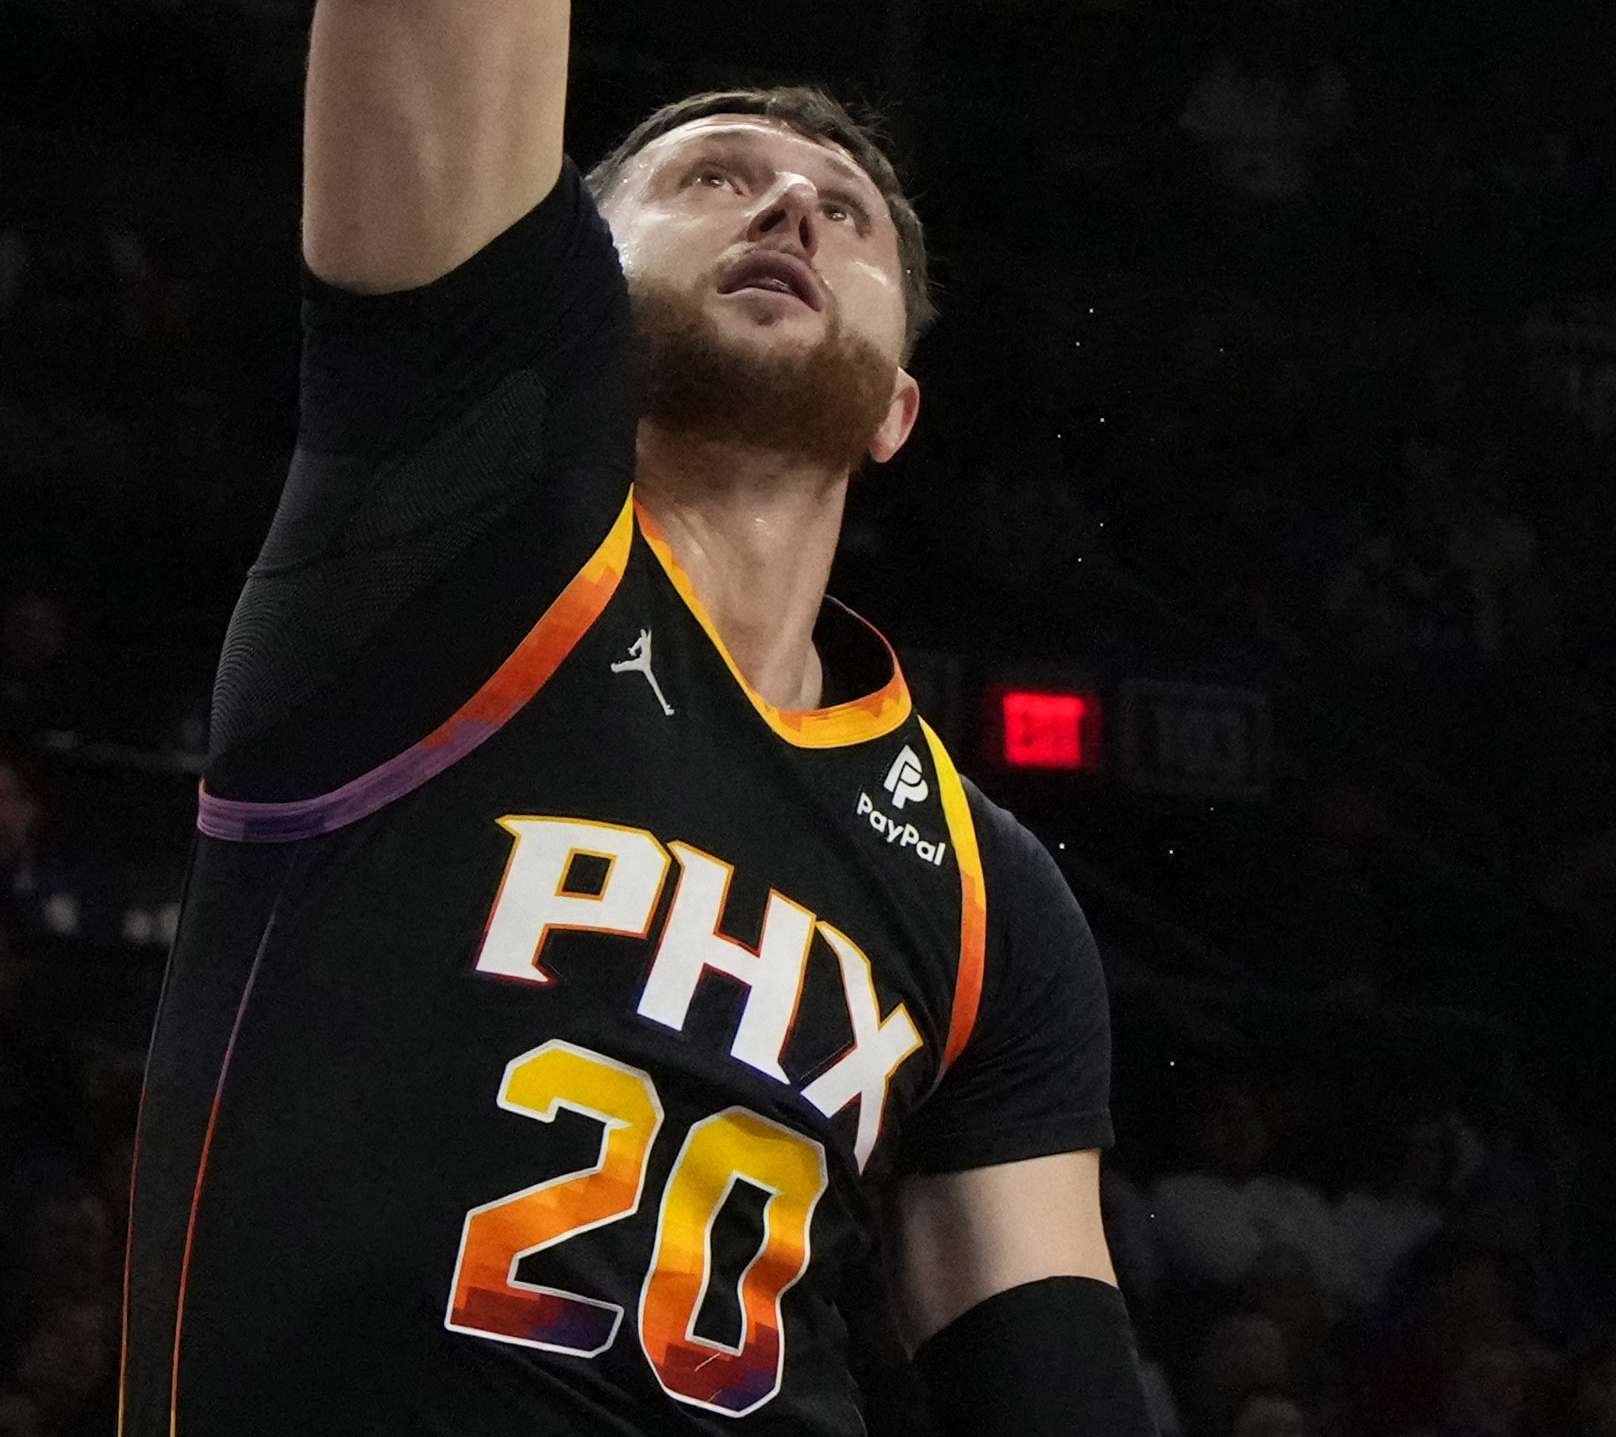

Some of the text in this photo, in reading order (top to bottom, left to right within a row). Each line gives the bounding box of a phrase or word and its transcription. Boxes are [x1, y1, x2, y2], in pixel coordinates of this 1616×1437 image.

[475, 814, 922, 1174] PHX
[856, 791, 946, 866] PayPal
[443, 1038, 828, 1419] 20
